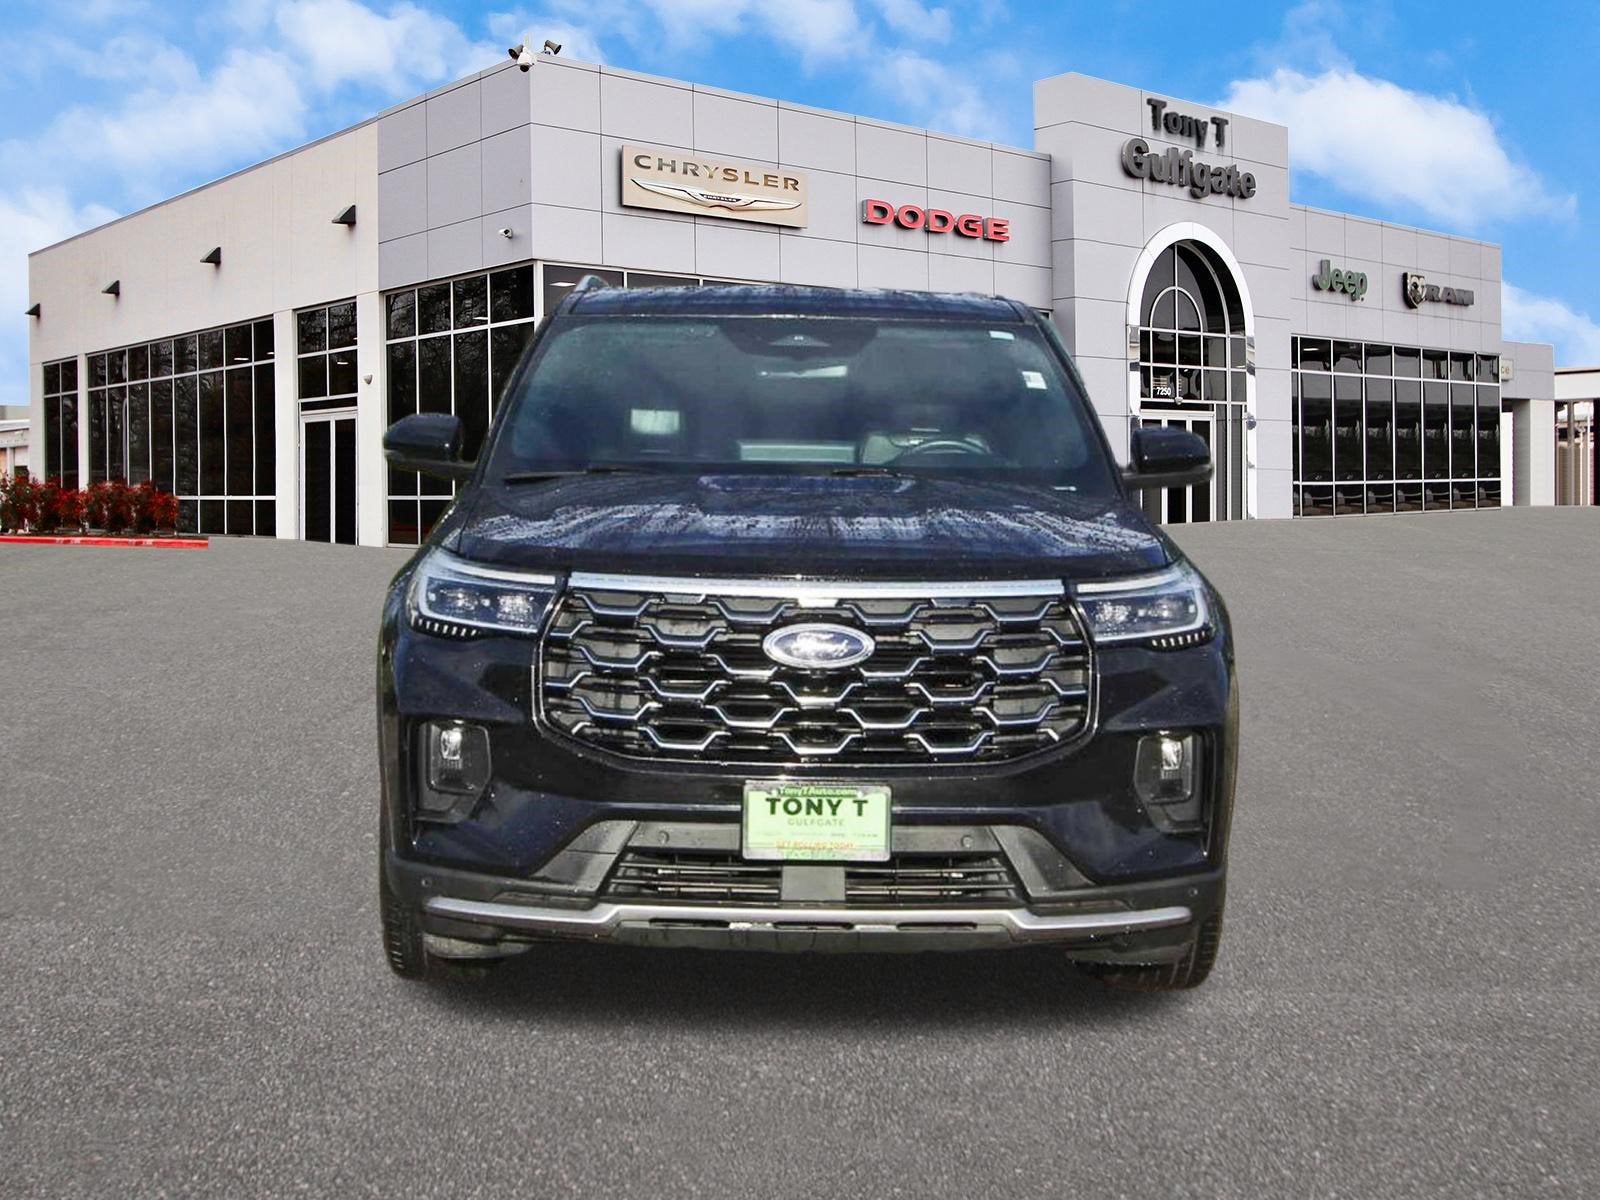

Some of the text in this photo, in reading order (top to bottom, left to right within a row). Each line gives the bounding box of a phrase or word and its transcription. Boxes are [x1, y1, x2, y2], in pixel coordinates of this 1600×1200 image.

[1147, 98, 1228, 148] Tony T
[634, 154, 800, 192] CHRYSLER
[1121, 137, 1256, 199] Gulfgate
[862, 199, 1010, 242] DODGE
[1312, 259, 1368, 302] Jeep
[1425, 283, 1475, 307] RAM
[765, 797, 868, 817] TONY T
[787, 818, 845, 828] GULFGATE
